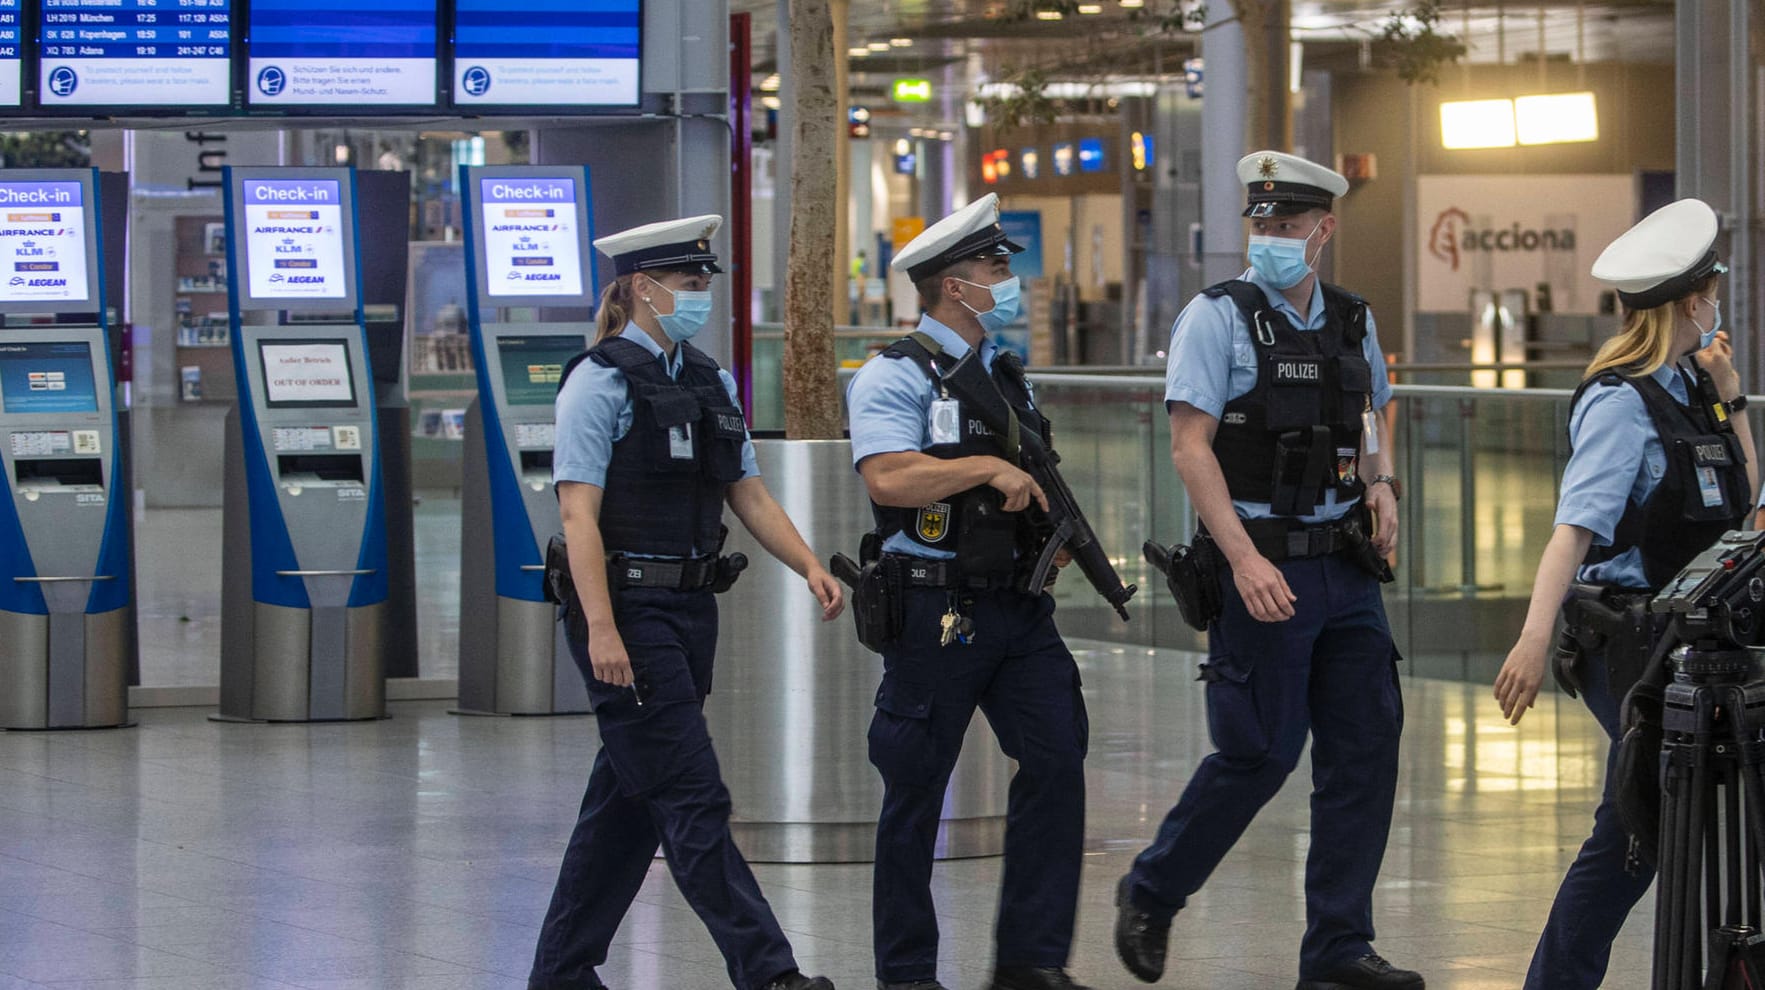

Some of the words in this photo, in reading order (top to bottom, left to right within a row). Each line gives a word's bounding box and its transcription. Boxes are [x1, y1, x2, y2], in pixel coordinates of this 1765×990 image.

[46, 14, 58, 22] LH
[80, 14, 114, 22] München
[136, 14, 157, 22] 17:25
[80, 30, 126, 40] Kopenhagen
[79, 46, 104, 55] Adana
[0, 188, 70, 202] Check-in
[256, 186, 328, 200] Check-in
[492, 184, 564, 198] Check-in
[1462, 221, 1575, 251] acciona
[1278, 363, 1318, 379] POLIZEI
[718, 414, 743, 432] POLIZEI
[76, 494, 104, 502] SITA
[337, 489, 366, 497] SITA
